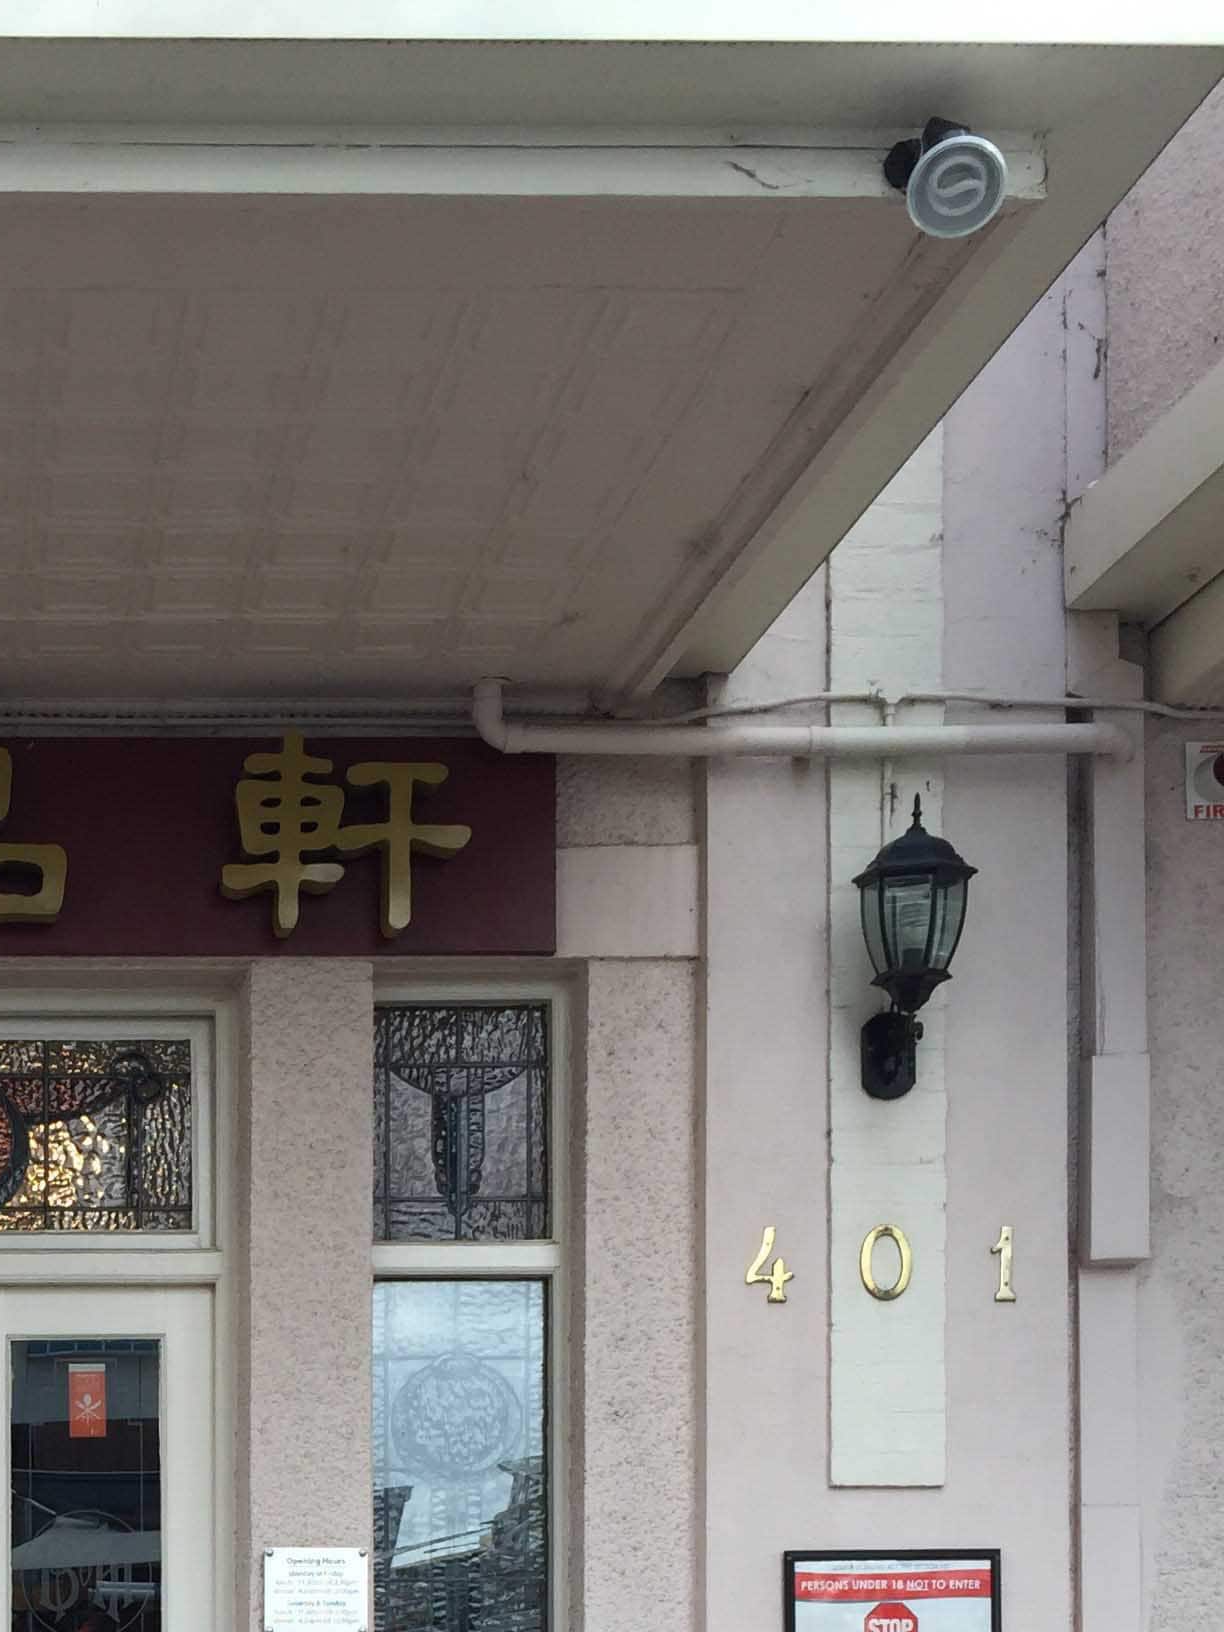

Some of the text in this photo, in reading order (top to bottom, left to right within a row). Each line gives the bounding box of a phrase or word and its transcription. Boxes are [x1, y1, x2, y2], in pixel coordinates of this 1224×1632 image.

[801, 1579, 980, 1592] PERSONS UNDER 18 NOT TO ENTER
